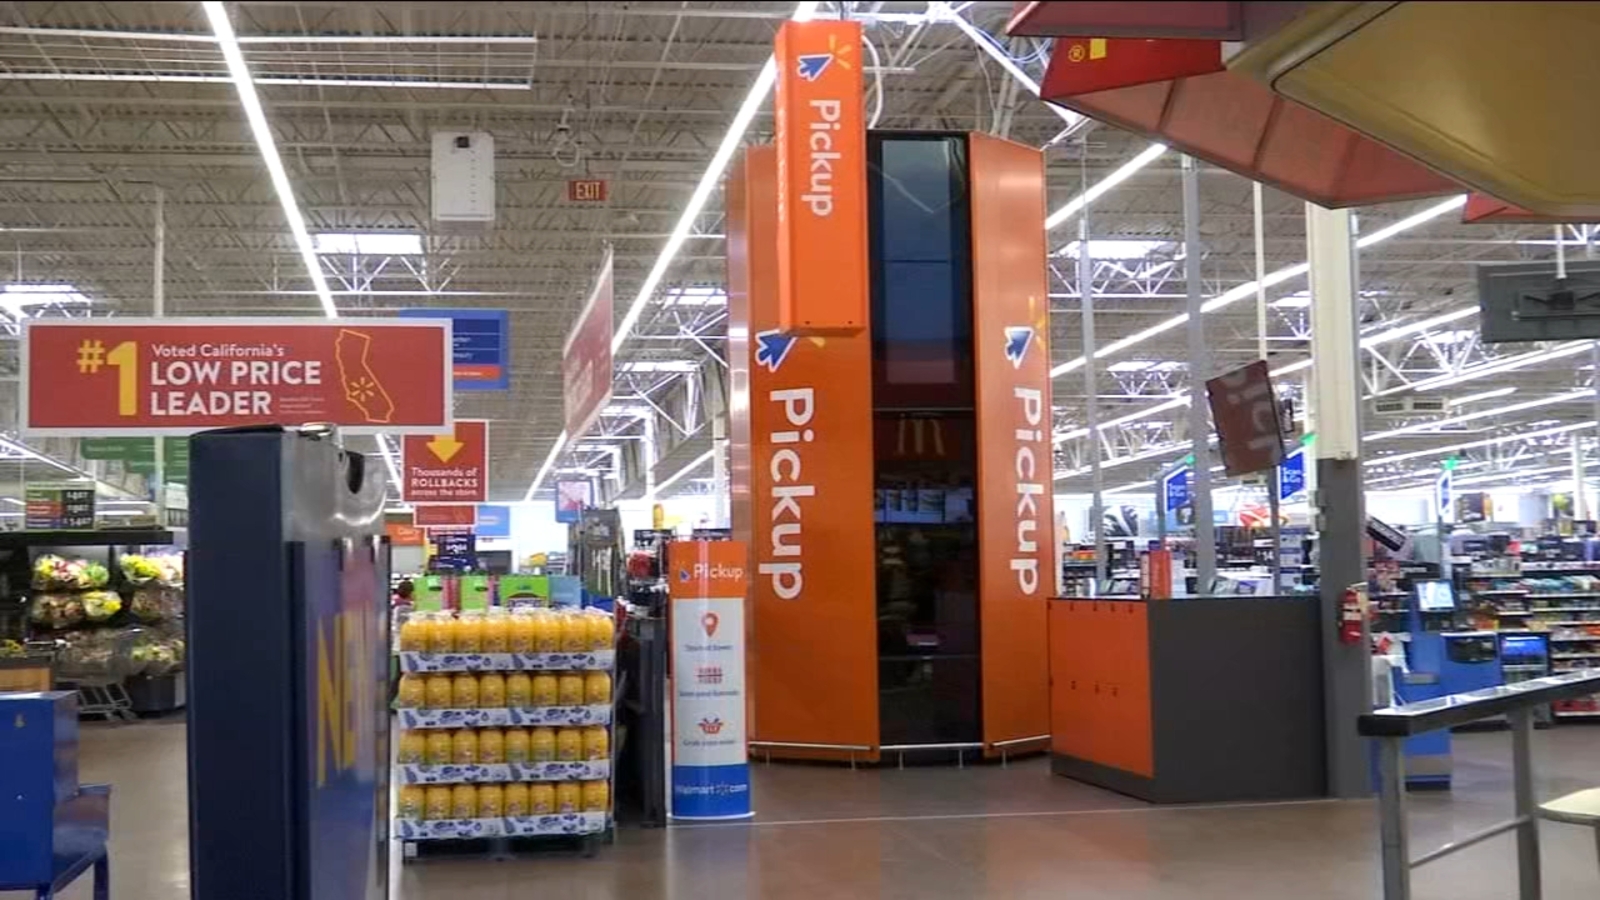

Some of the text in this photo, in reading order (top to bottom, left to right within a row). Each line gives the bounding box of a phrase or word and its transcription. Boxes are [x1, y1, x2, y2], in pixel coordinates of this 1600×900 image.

[801, 99, 841, 217] Pickup
[576, 181, 600, 200] EXIT
[152, 343, 285, 357] Voted California's
[77, 339, 138, 416] #1
[151, 360, 322, 386] LOW PRICE
[151, 390, 272, 416] LEADER
[411, 467, 478, 477] Thousands of
[411, 478, 478, 488] ROLLBACKS
[758, 387, 816, 600] Pickup
[1009, 387, 1044, 595] Pickup
[693, 563, 744, 582] Pickup
